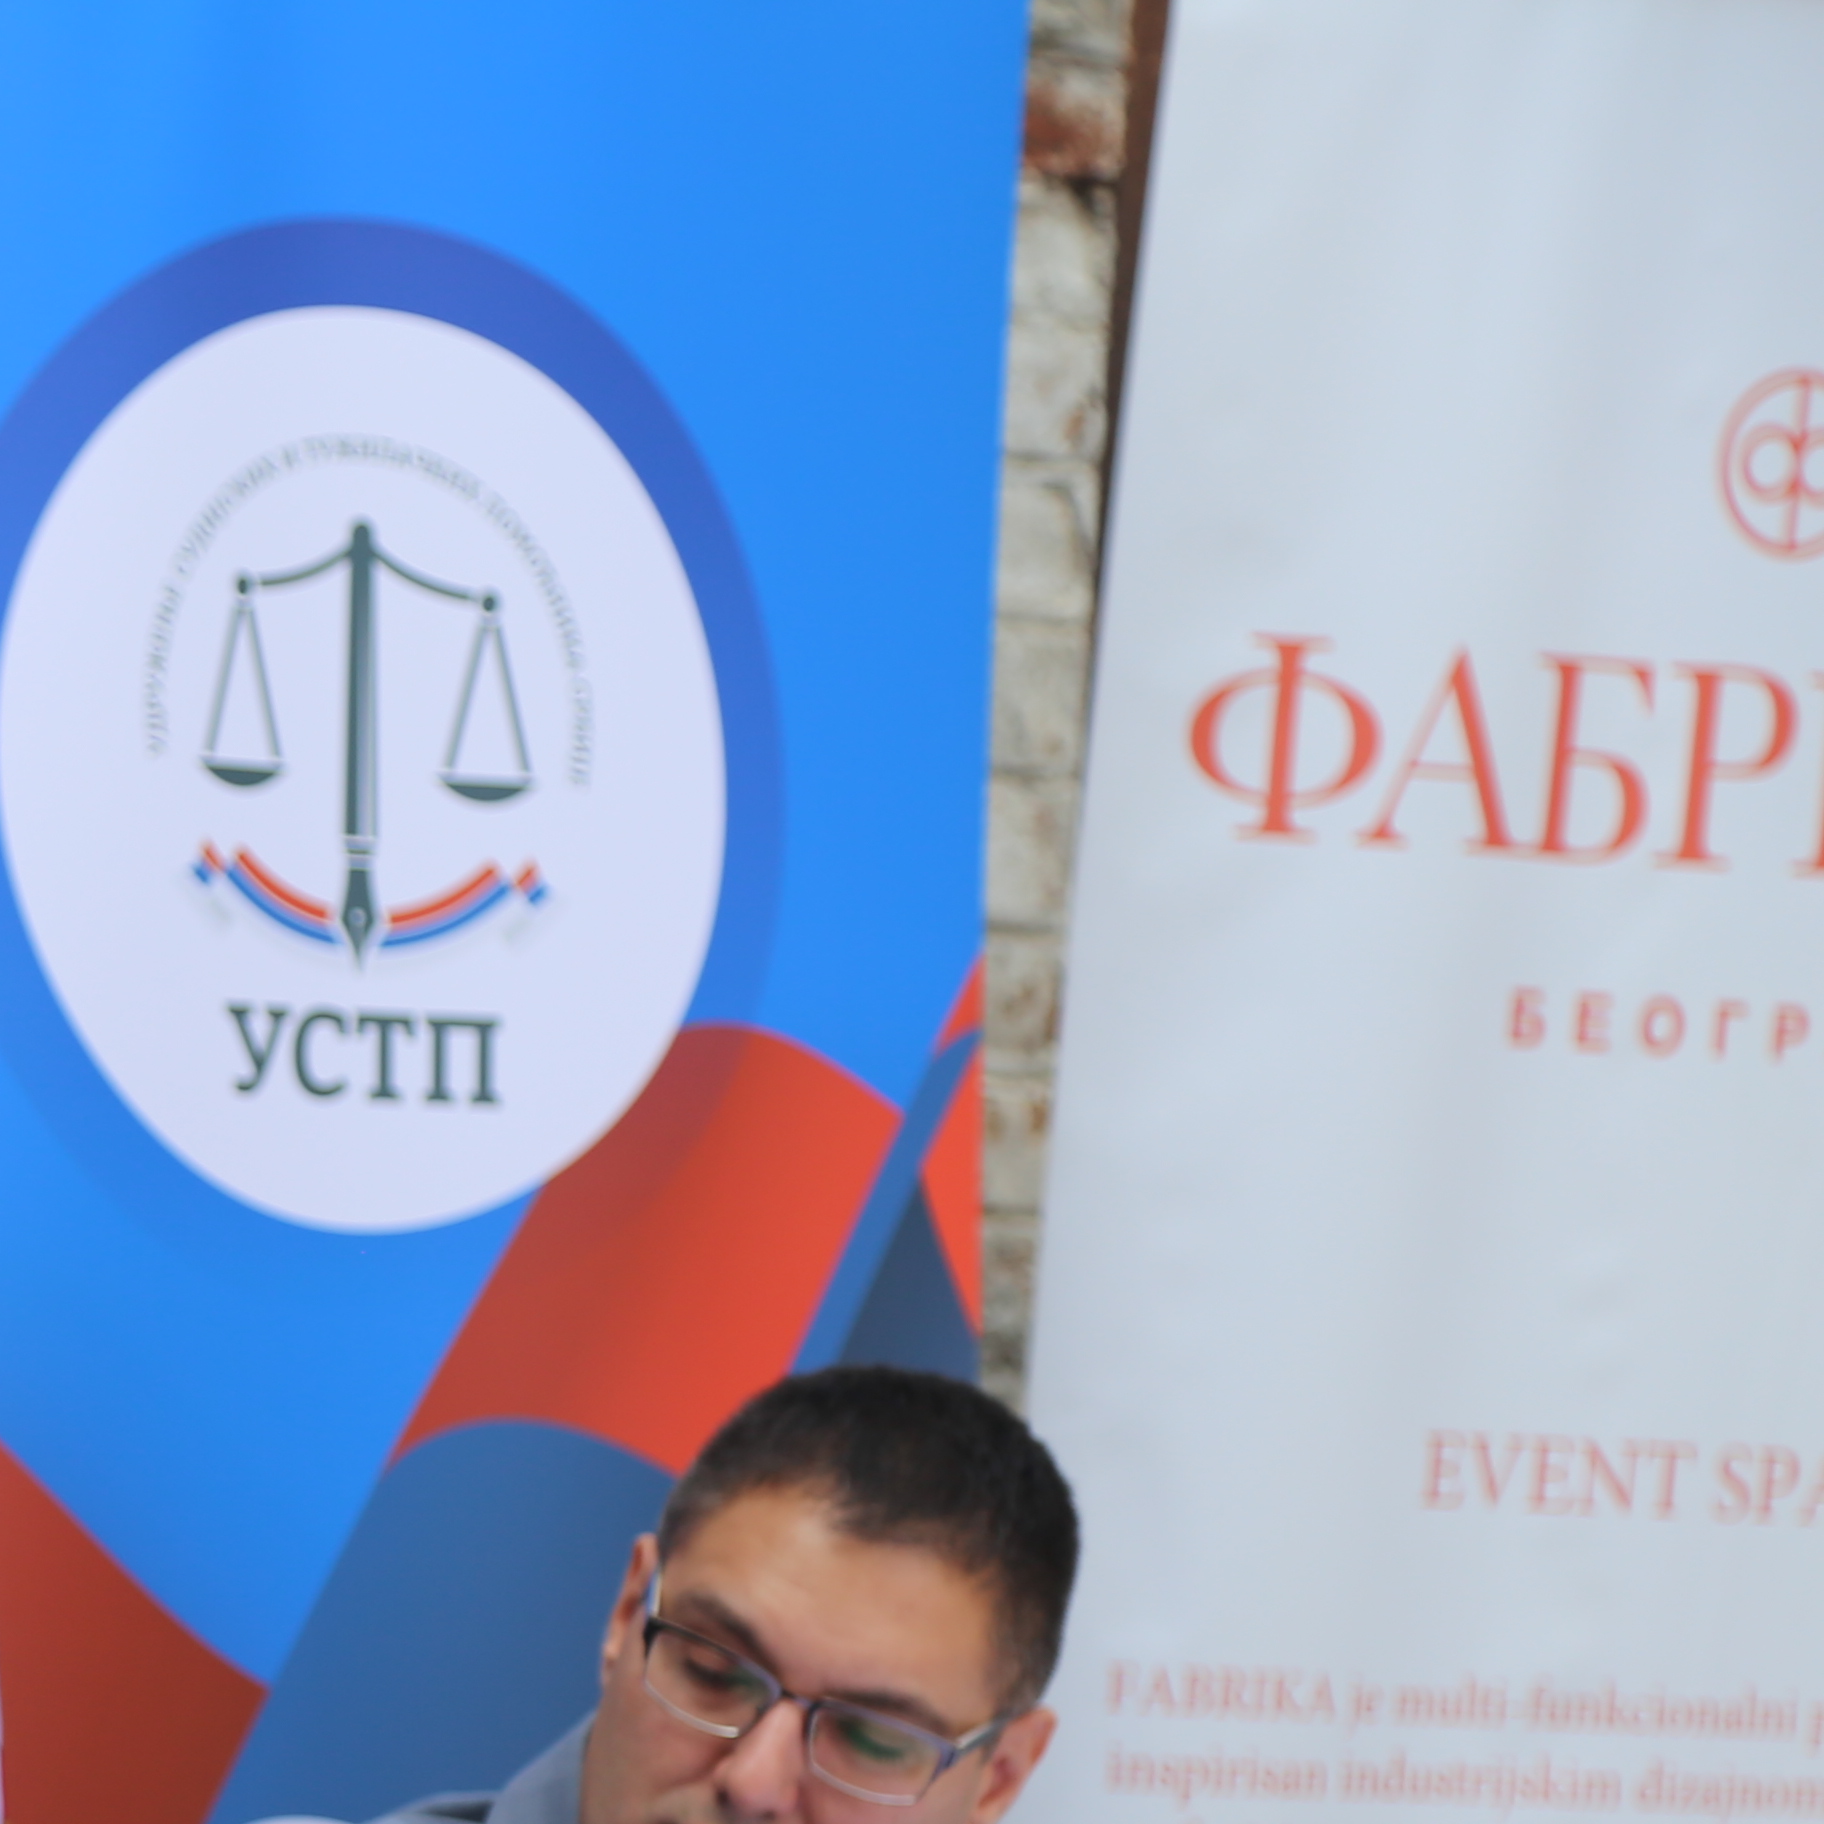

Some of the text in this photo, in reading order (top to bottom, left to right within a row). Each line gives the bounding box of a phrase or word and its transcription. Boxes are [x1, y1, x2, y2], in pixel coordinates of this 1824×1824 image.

[1184, 630, 1824, 880] ФАБР
[225, 998, 505, 1108] УСТП
[1506, 986, 1812, 1062] БЕОГР
[1422, 1430, 1698, 1518] EVENT
[1107, 1658, 1335, 1724] FABRIKA
[1347, 1672, 1383, 1740] je
[1106, 1741, 1328, 1809] inspirisan
[1337, 1748, 1621, 1822] industrijskim
